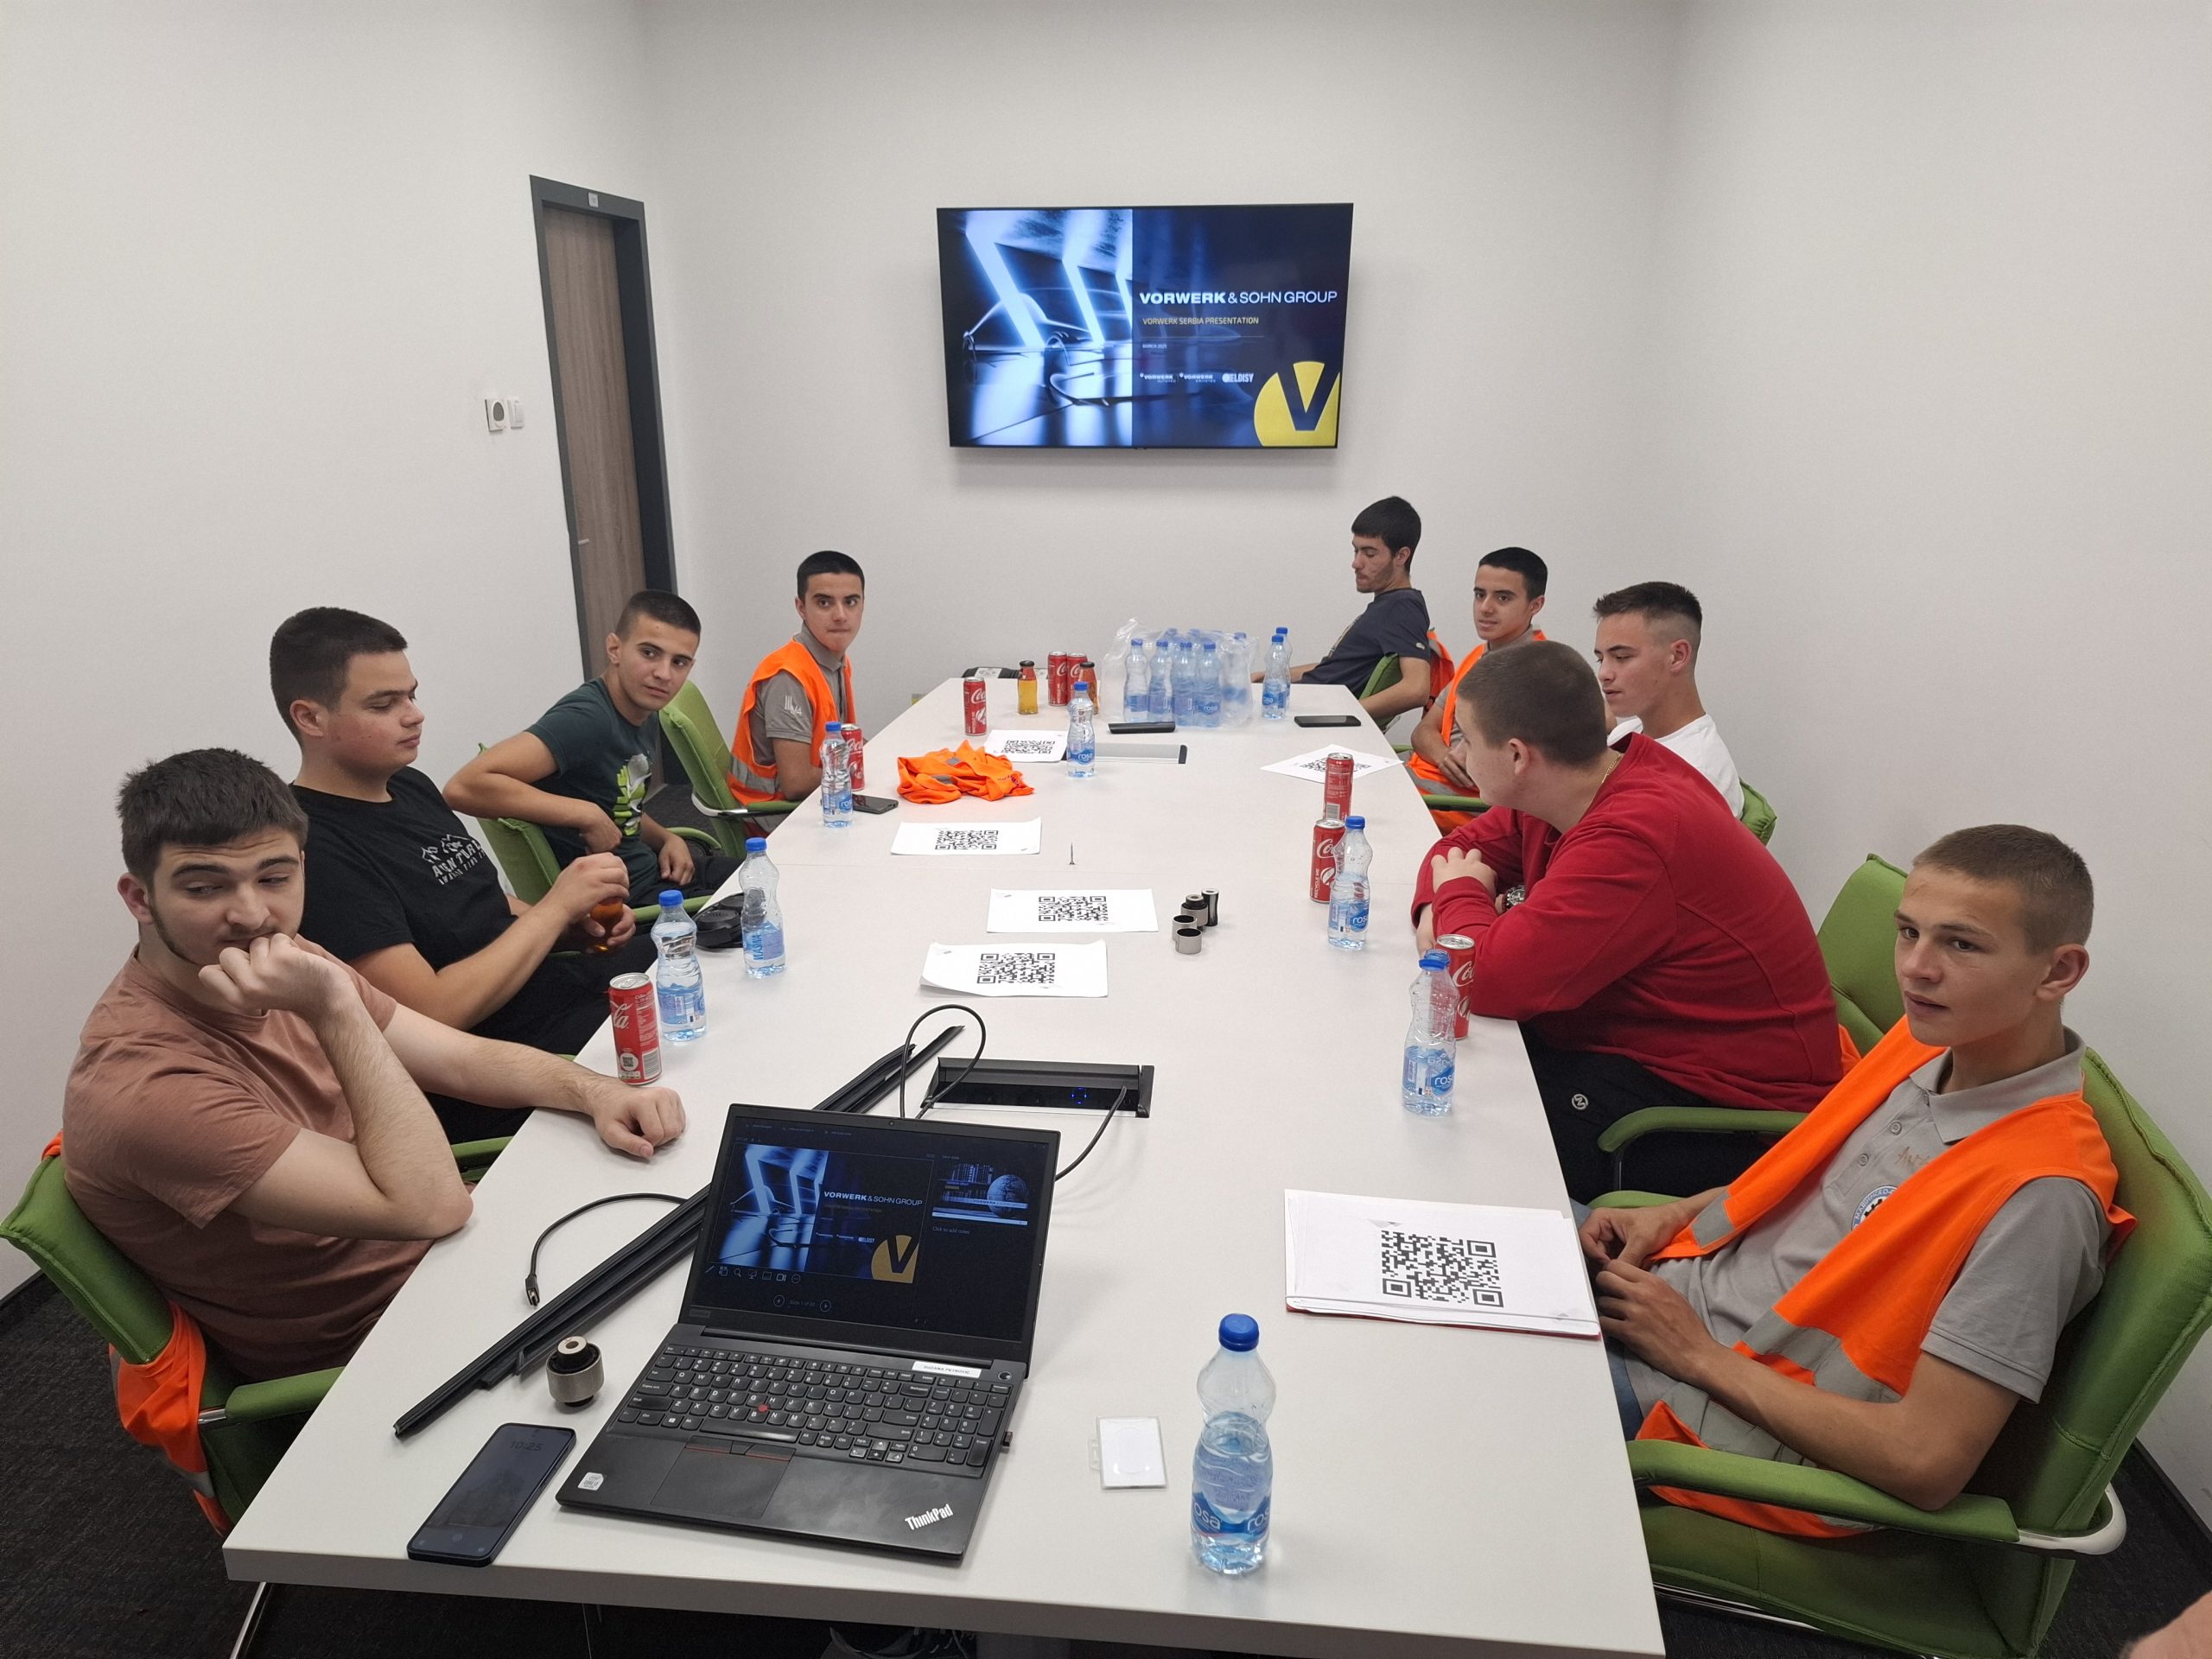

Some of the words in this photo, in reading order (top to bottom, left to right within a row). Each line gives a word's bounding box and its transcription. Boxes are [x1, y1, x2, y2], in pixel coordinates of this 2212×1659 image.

[1140, 292, 1226, 304] VORWERK
[1228, 291, 1237, 304] &
[1239, 291, 1281, 303] SOHN
[1284, 290, 1338, 303] GROUP
[1230, 373, 1254, 383] ELDISY
[752, 934, 764, 961] VLASINA
[824, 1192, 867, 1201] VORWERK
[895, 1198, 923, 1206] GROUP
[511, 1440, 544, 1452] 10:25
[905, 1503, 954, 1530] ThinkPad
[1192, 1497, 1221, 1530] osa
